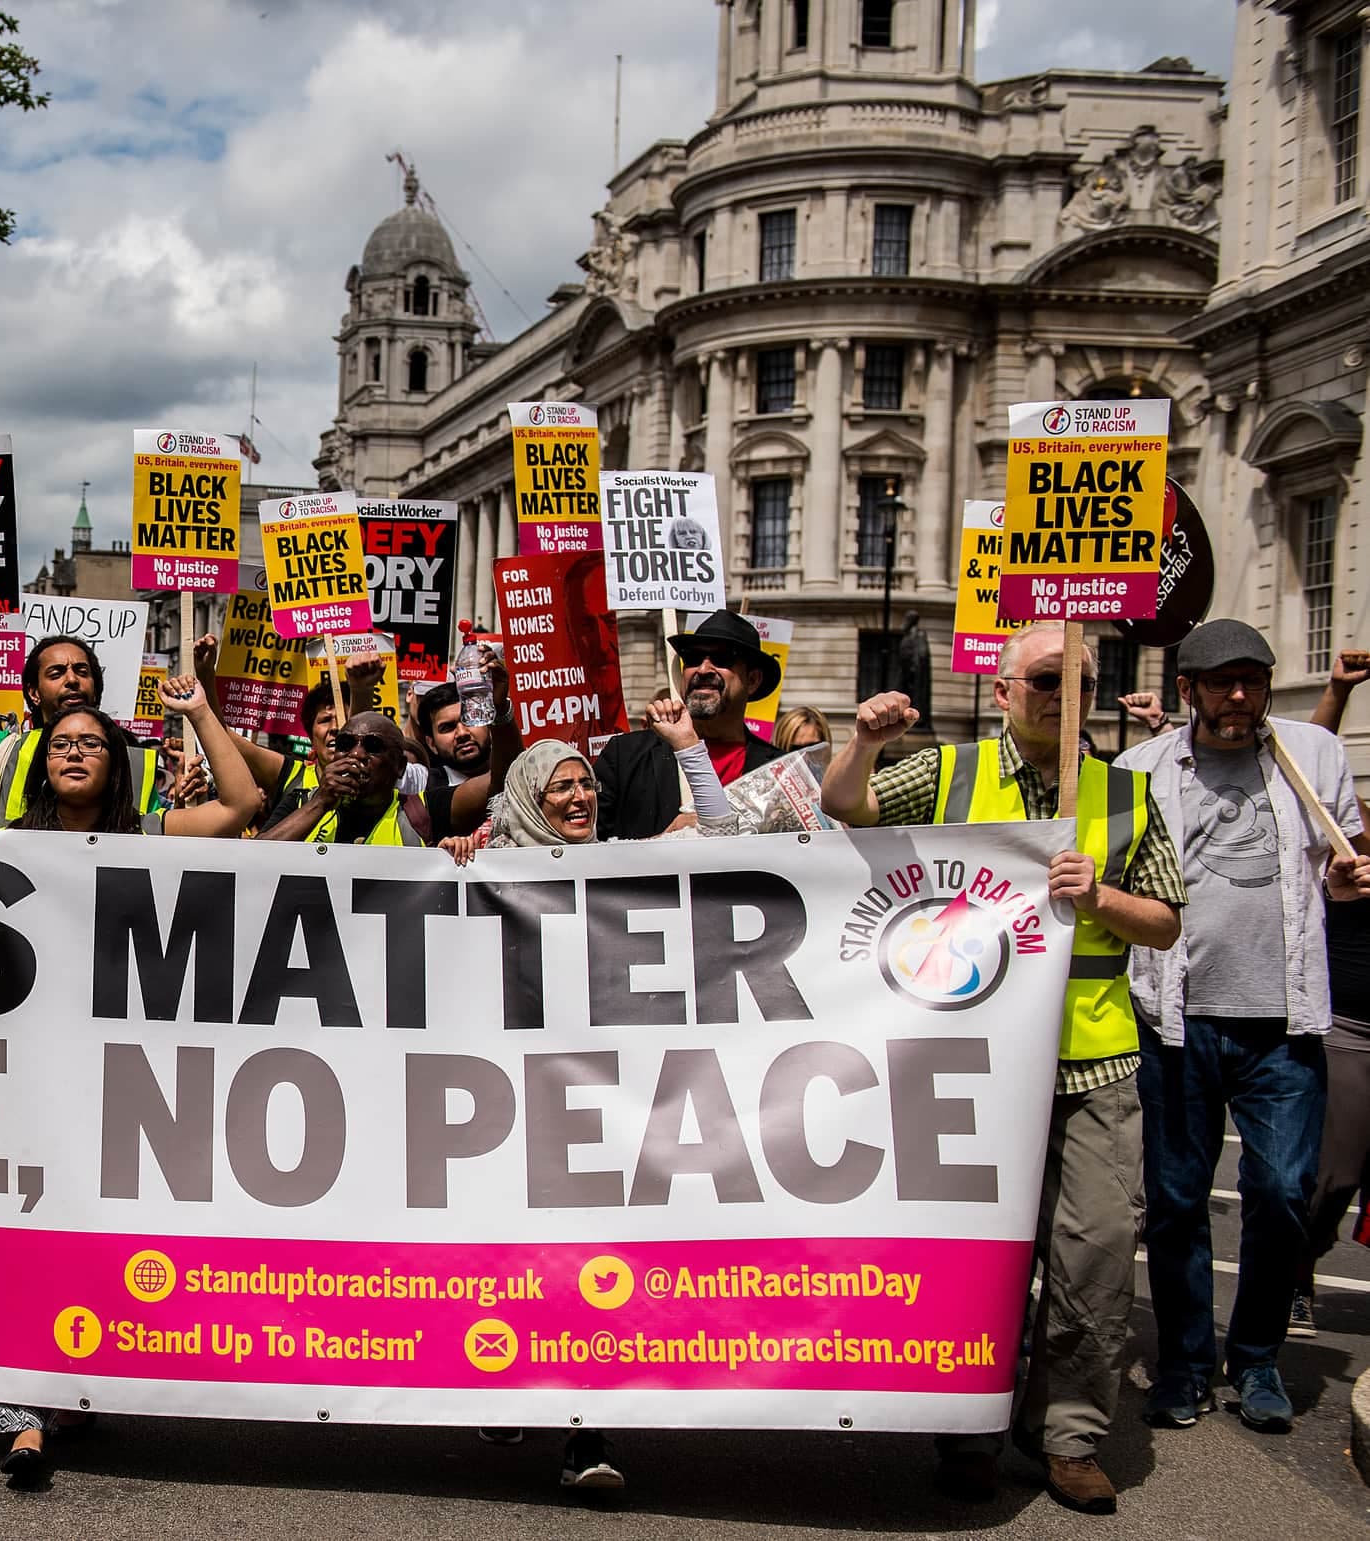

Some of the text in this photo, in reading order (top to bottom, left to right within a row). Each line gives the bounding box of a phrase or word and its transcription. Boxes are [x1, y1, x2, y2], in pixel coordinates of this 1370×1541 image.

[1075, 408, 1130, 420] STAND UP
[1075, 420, 1136, 433] TO RACISM
[179, 435, 216, 445] STAND UP
[179, 445, 221, 455] TO RACISM
[1013, 440, 1162, 455] US, Britain, everywhere
[138, 456, 238, 471] US, Britain, everywhere
[526, 443, 589, 466] BLACK
[149, 472, 228, 500] BLACK
[532, 468, 586, 491] LIVES
[614, 477, 699, 488] Socialist Worker
[1029, 460, 1145, 495] BLACK
[154, 498, 221, 525] LIVES
[521, 492, 599, 515] MATTER
[606, 487, 690, 519] FIGHT
[1035, 496, 1133, 529] LIVES
[138, 523, 235, 552] MATTER
[277, 529, 350, 558] BLACK
[536, 525, 589, 540] No justice
[607, 519, 666, 550] THE
[540, 538, 587, 553] No peace
[1009, 530, 1156, 564] MATTER
[153, 558, 219, 576] No justice
[284, 552, 347, 579] LIVES
[502, 569, 529, 583] FOR
[610, 551, 715, 584] TORIES
[156, 573, 216, 590] No peace
[273, 573, 364, 603] MATTER
[1031, 578, 1128, 600] No justice
[505, 586, 552, 608] HEALTH
[619, 587, 715, 606] Defend Corbyn
[1034, 597, 1122, 618] No peace
[292, 605, 352, 623] No justice
[509, 614, 555, 636] HOMES
[296, 618, 351, 634] No peace
[244, 651, 292, 679] here
[513, 643, 545, 664] JOBS
[515, 666, 585, 692] EDUCATION
[519, 693, 601, 736] JC4PM
[839, 859, 1047, 962] STAND UP TO RACISM
[92, 867, 813, 1030] MATTER
[100, 1043, 347, 1207] NO
[405, 1038, 998, 1209] PEACE
[185, 1264, 543, 1306] standuptoracism.org.uk
[644, 1264, 921, 1305] @AntiRacismDay
[211, 1324, 253, 1363] Up
[262, 1326, 295, 1357] To
[530, 1329, 996, 1372] info@standuptoracism.org.uk
